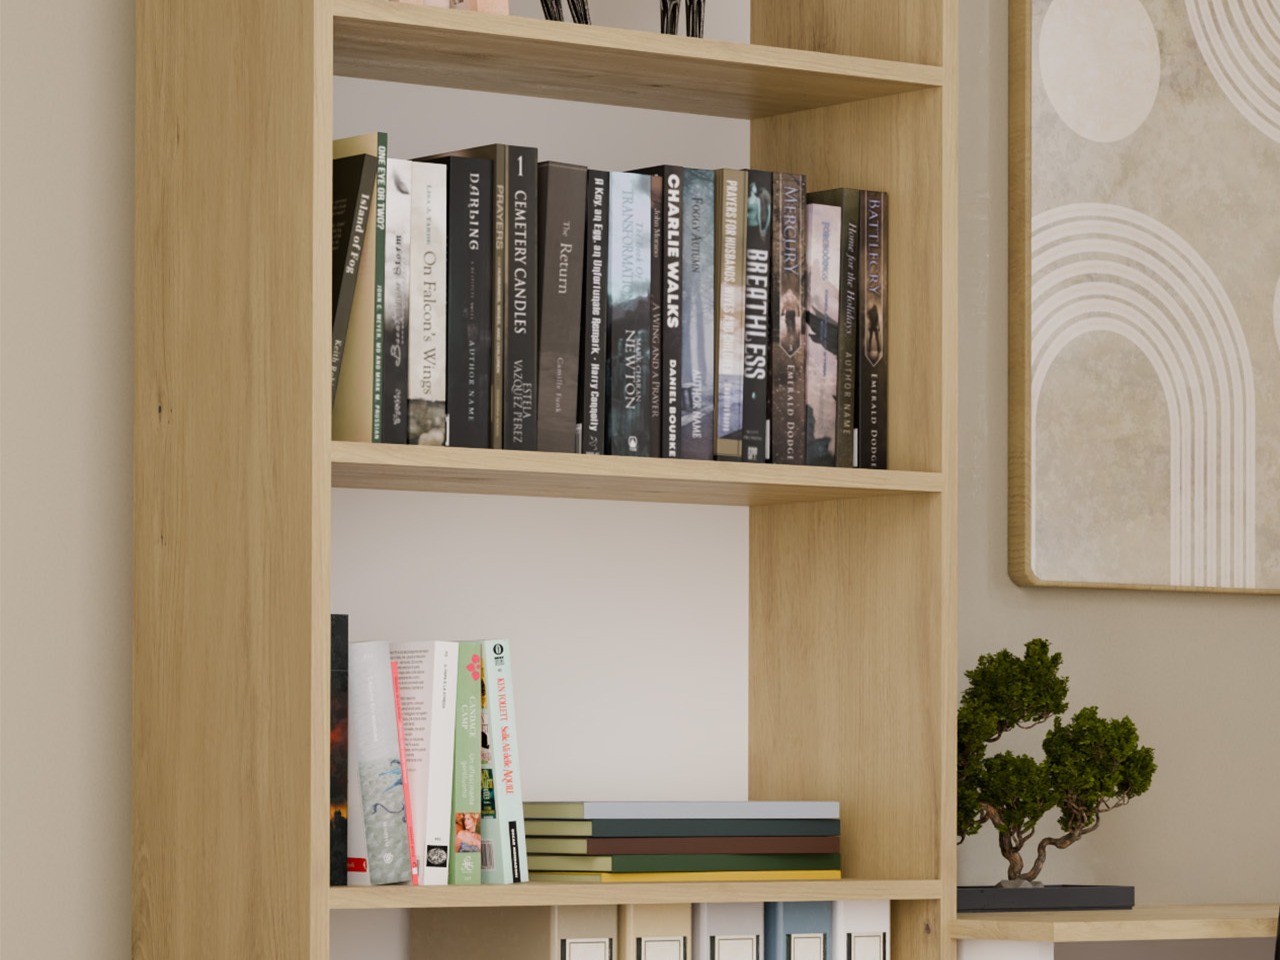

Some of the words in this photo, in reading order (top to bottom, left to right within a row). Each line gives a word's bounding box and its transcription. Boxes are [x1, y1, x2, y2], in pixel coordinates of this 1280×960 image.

[377, 146, 386, 167] ONE
[517, 155, 523, 177] 1
[376, 187, 386, 201] OR
[377, 167, 386, 187] EYE
[594, 178, 604, 186] A
[355, 194, 370, 234] Island
[376, 201, 385, 231] TWO?
[468, 173, 480, 250] DARLING
[496, 184, 504, 250] PRAYERS
[593, 208, 602, 222] an
[667, 174, 680, 258] CHARLIE
[692, 197, 704, 231] FOGGY
[725, 180, 738, 219] PRAYERS
[351, 235, 361, 252] of
[514, 190, 527, 265] CEMETERY
[562, 221, 570, 237] The
[725, 220, 737, 235] FOR
[783, 186, 799, 276] MERCURY
[847, 222, 857, 253] Home
[345, 252, 359, 274] Fog
[423, 251, 436, 276] On
[559, 243, 572, 294] Return
[592, 244, 602, 258] an
[691, 234, 702, 273] AUTUMN
[845, 253, 856, 269] for
[591, 259, 602, 316] Unfortunate
[667, 261, 680, 329] WALKS
[847, 270, 855, 286] the
[423, 282, 436, 342] Falcon's
[513, 268, 527, 334] CANDLES
[652, 302, 660, 310] A
[745, 249, 768, 380] BREATHLESS
[846, 290, 855, 335] Holidays
[591, 317, 601, 355] Remark
[652, 312, 660, 344] WING
[375, 342, 382, 354] MD
[421, 347, 436, 395] Wings
[511, 359, 523, 408] VAZQUEZ
[590, 363, 600, 390] Harry
[625, 329, 636, 409] NEWTON
[668, 359, 677, 404] DANIEL
[844, 352, 852, 398] AUTHOR
[522, 382, 532, 419] ESTELA
[691, 370, 702, 410] AUTHOR
[787, 364, 795, 416] EMERALD
[513, 411, 523, 443] PEREZ
[588, 392, 599, 432] Connolly
[691, 411, 702, 438] NAME
[843, 403, 851, 434] NAME
[668, 406, 676, 457] BOURKE
[786, 421, 795, 459] DODGE
[870, 429, 878, 467] DODGE
[496, 677, 504, 692] KEN
[498, 694, 508, 721] FOLLETT
